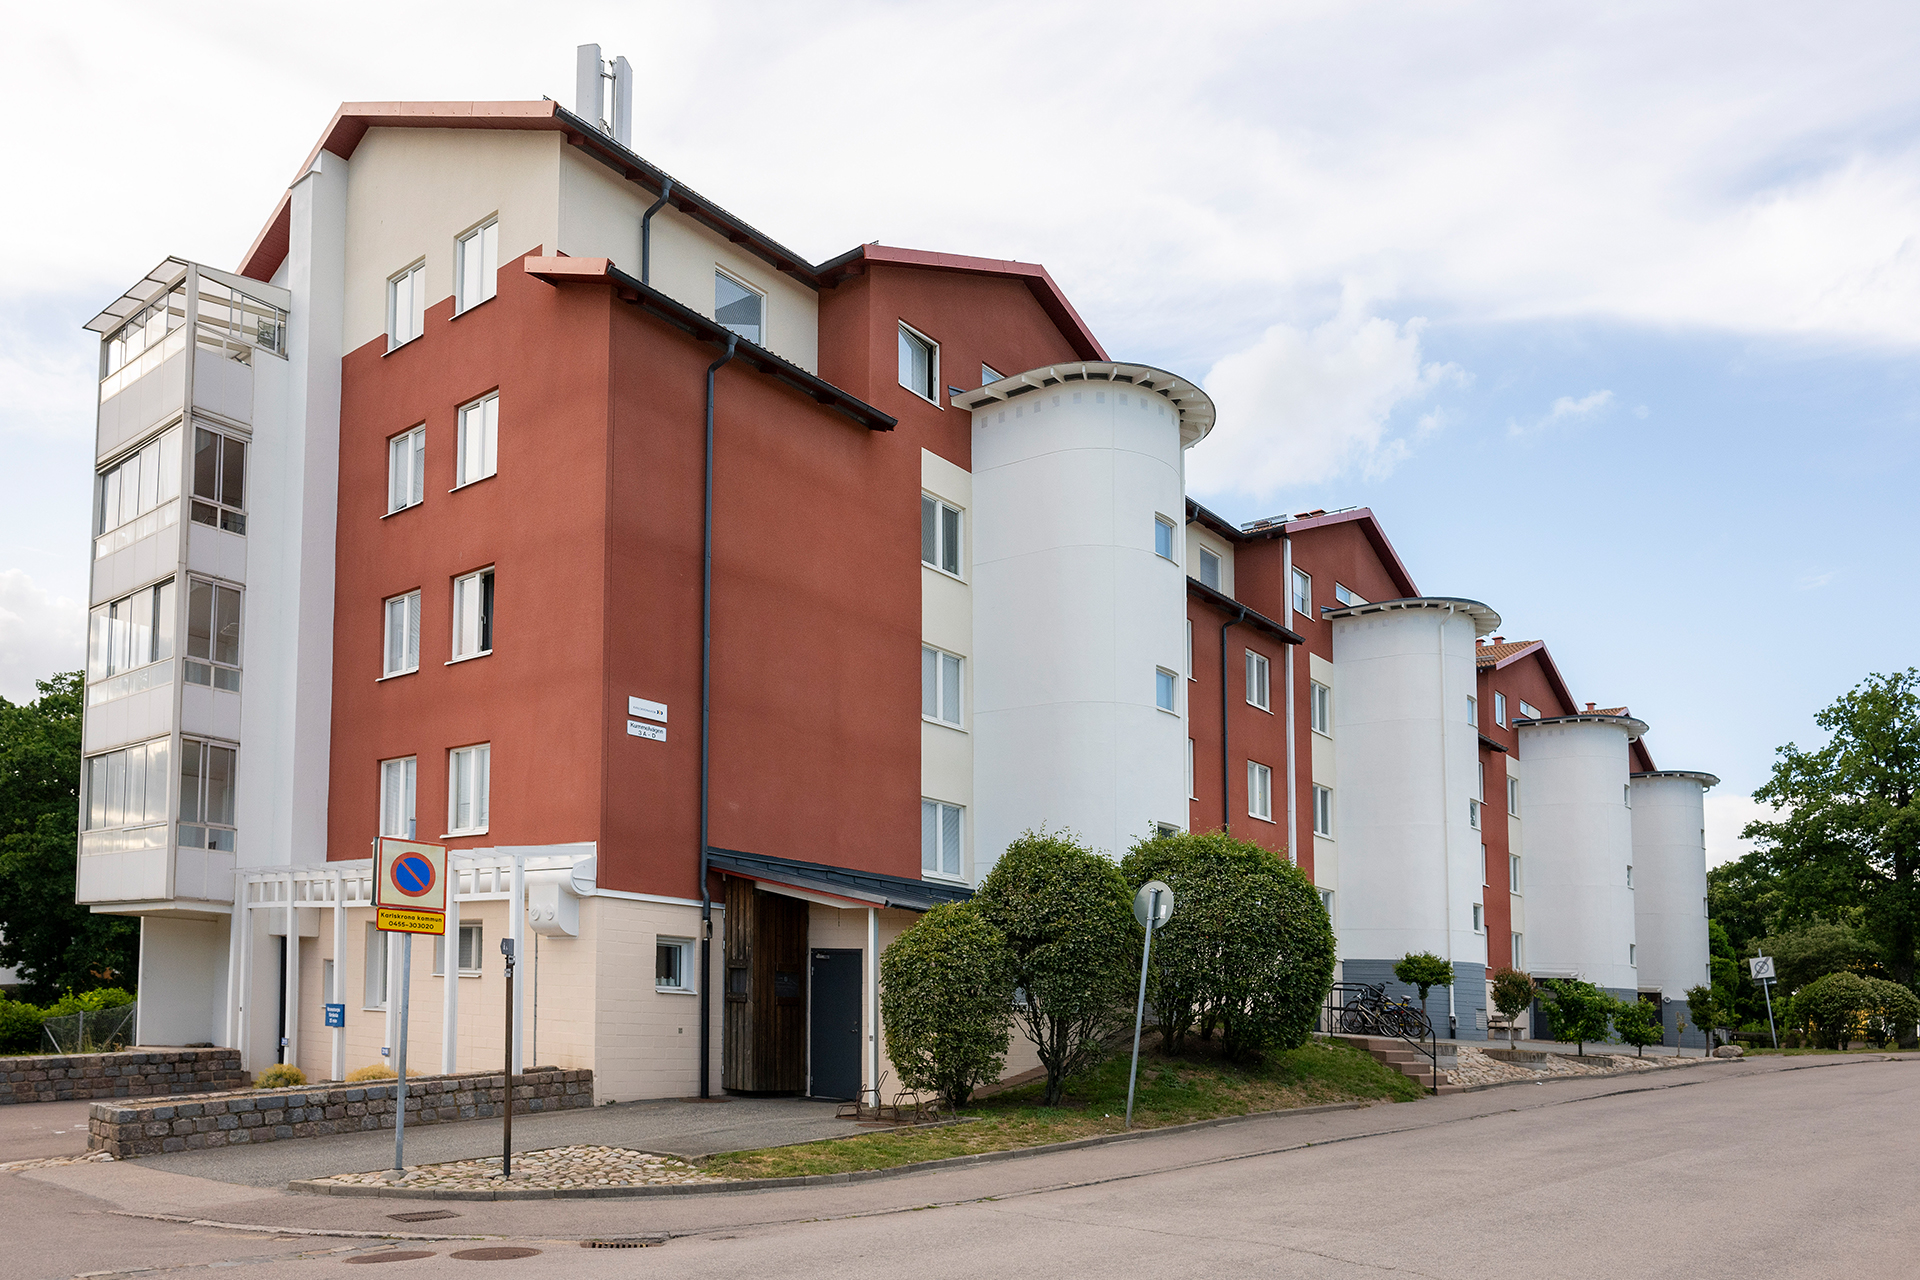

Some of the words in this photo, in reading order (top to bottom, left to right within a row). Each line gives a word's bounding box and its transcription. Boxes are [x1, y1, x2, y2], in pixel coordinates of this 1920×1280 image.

[630, 722, 664, 735] Kummelvägen
[380, 912, 416, 921] Karlskrona
[417, 915, 443, 923] kommun
[388, 920, 435, 930] 0455-303020
